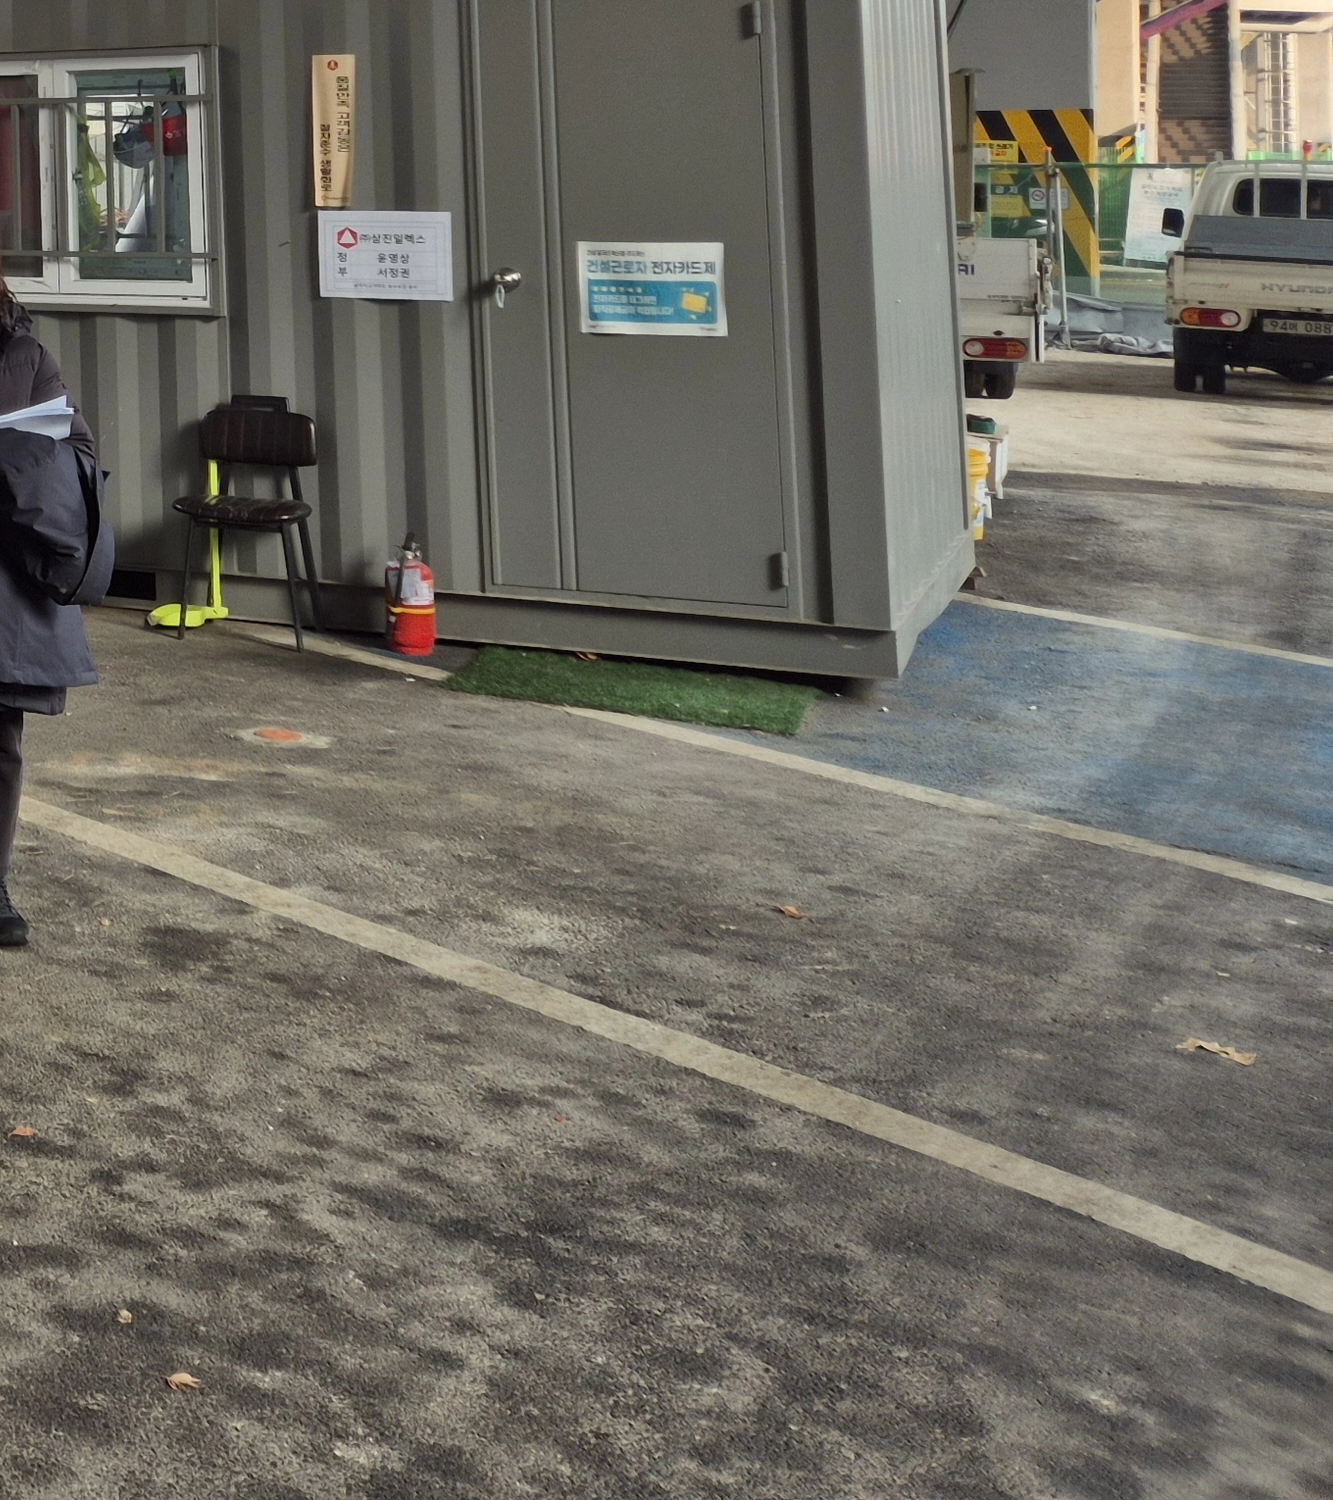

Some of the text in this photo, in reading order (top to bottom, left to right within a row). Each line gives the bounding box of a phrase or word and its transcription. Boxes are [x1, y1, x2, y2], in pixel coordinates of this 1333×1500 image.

[337, 252, 347, 263] 정
[337, 266, 348, 277] 부
[586, 259, 717, 275] 건설근로자 전자카드제
